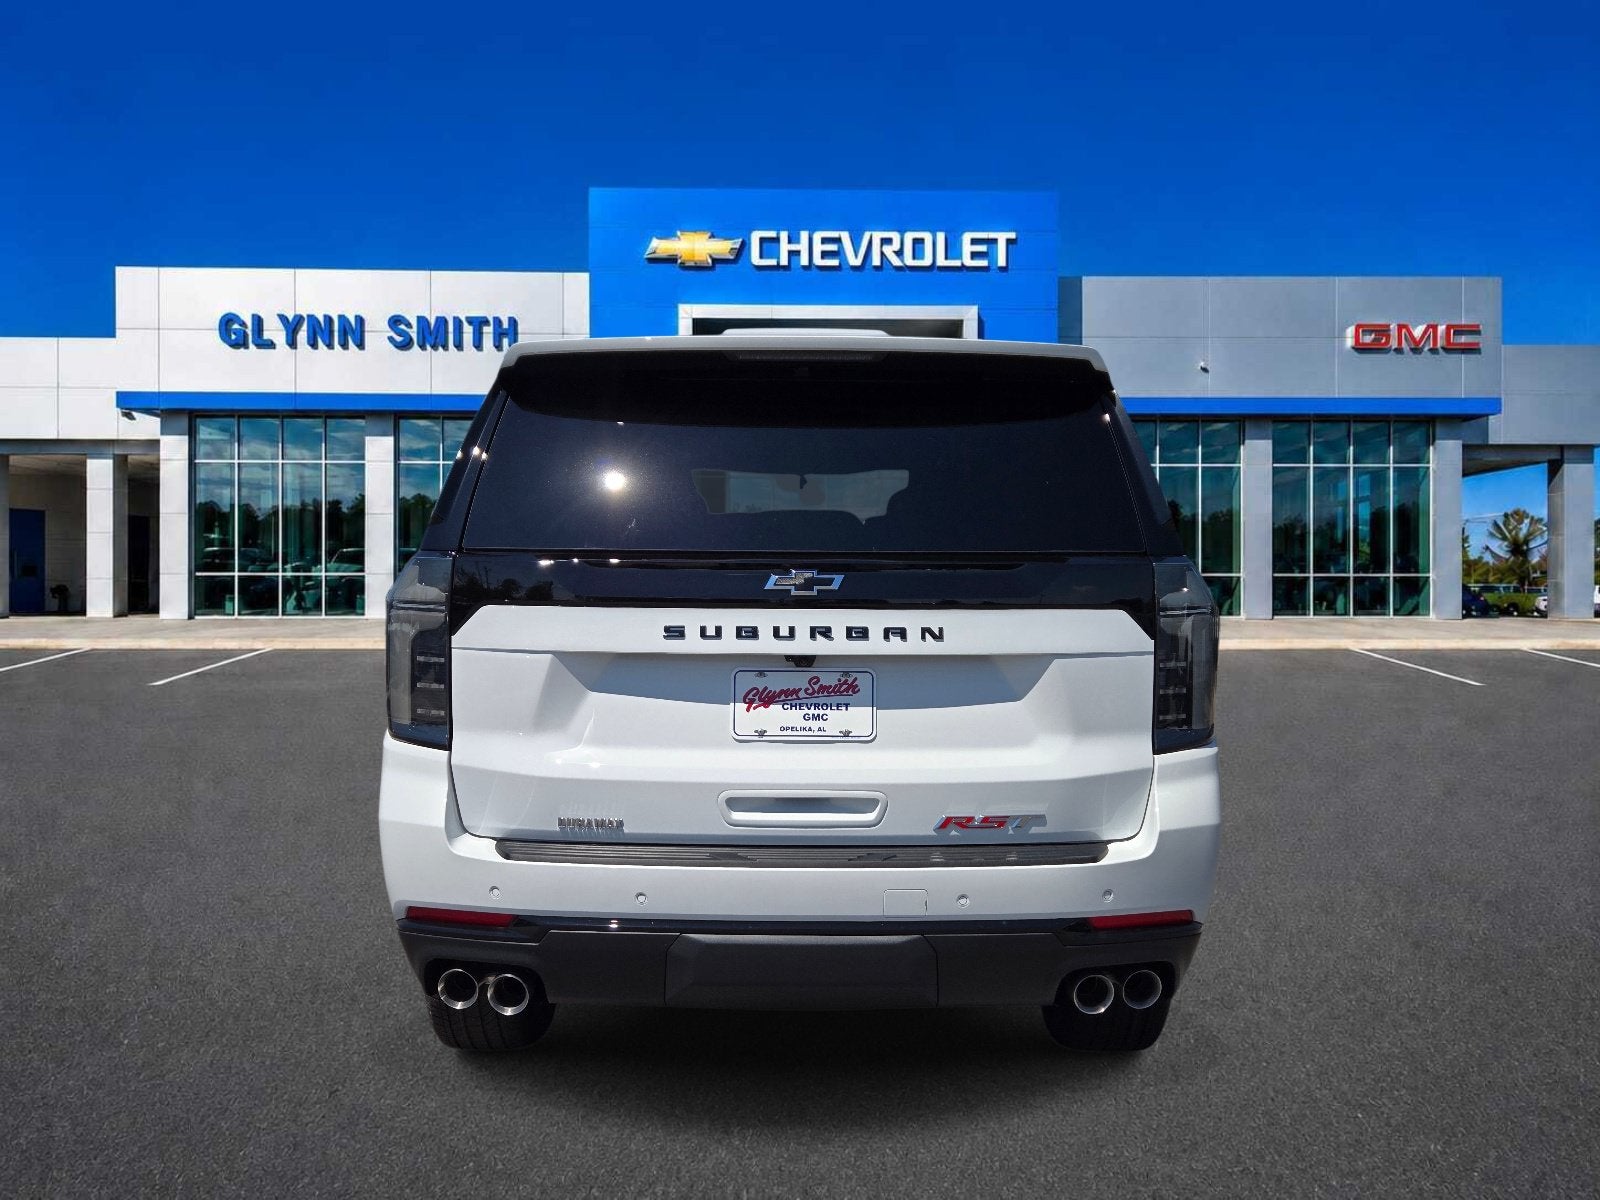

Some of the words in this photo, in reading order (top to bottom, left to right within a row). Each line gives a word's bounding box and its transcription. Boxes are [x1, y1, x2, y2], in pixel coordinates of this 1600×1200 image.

[750, 230, 1017, 269] CHEVROLET
[218, 312, 366, 350] GLYNN
[386, 313, 519, 351] SMITH
[1351, 323, 1482, 353] GMC
[662, 624, 946, 643] SUBURBAN
[742, 686, 803, 713] Glynn
[804, 675, 861, 696] Smith
[781, 702, 851, 712] CHEVROLET
[802, 713, 829, 722] GMC
[779, 726, 816, 734] OPELIKA,
[934, 814, 1047, 830] RST
